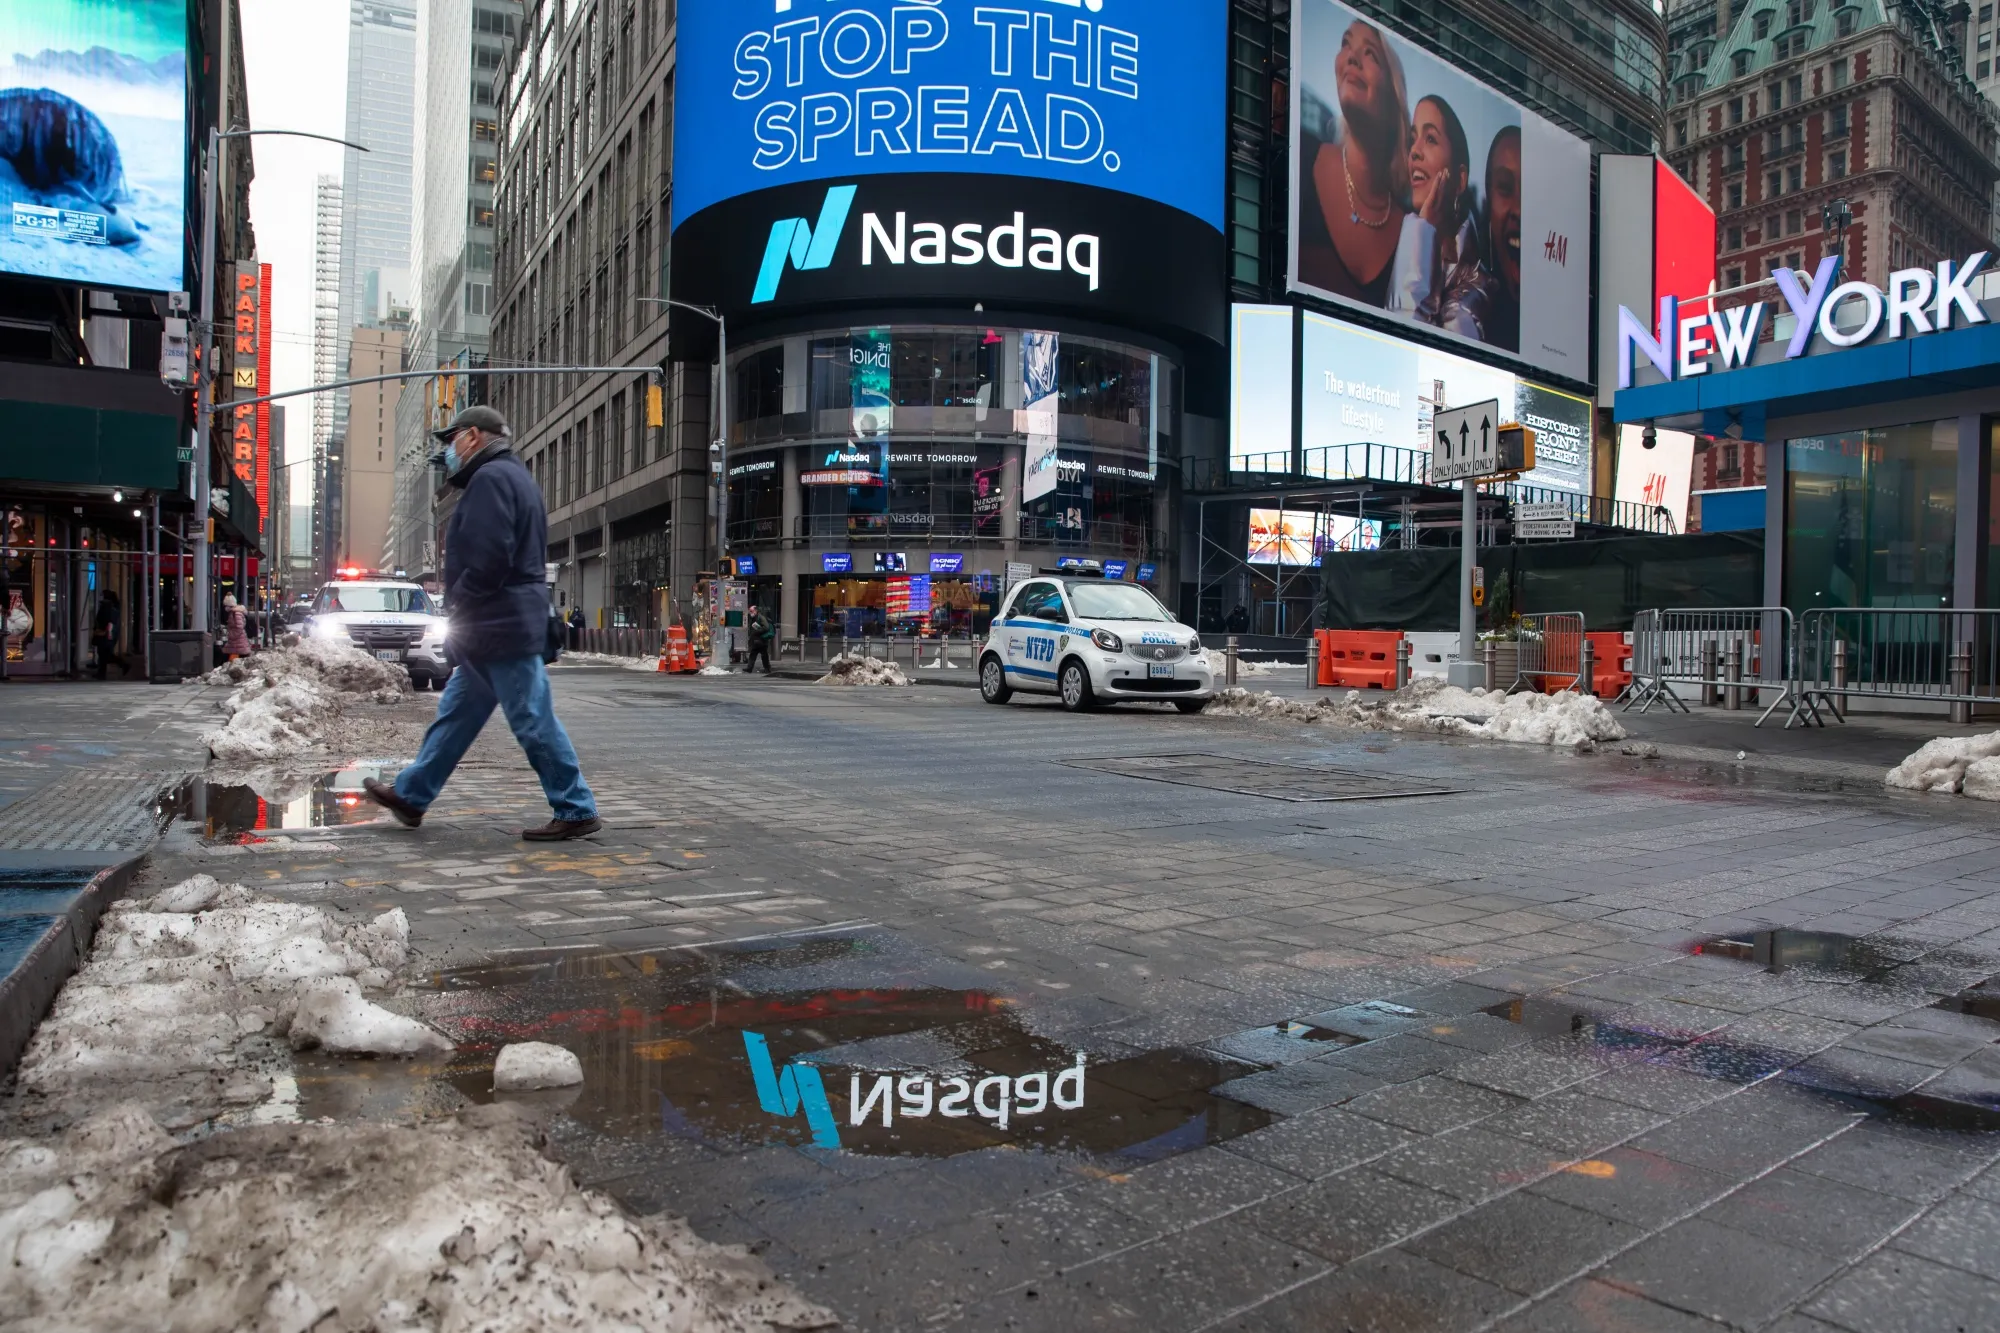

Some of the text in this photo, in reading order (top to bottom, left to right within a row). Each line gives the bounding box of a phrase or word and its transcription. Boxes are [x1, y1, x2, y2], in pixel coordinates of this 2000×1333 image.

[732, 6, 1139, 100] STOP THE
[752, 86, 1121, 172] SPREAD.
[15, 213, 57, 229] PG-13
[861, 211, 1100, 292] Nasdaq
[1543, 230, 1568, 268] H&M
[235, 273, 256, 354] PARK
[1324, 370, 1401, 410] The waterfront
[1342, 403, 1384, 436] lifestyle
[1526, 413, 1581, 437] HISTORIC
[234, 402, 254, 481] PARK
[1534, 431, 1580, 452] RONT
[839, 453, 870, 464] Nasdaq
[885, 454, 978, 463] REWRITE TOMORROW
[1474, 457, 1494, 471] ONLY
[1534, 446, 1580, 465] TREET
[746, 460, 776, 472] TOMORROW
[1056, 460, 1085, 472] Nasdaq
[1098, 465, 1126, 476] REWRITE
[1434, 465, 1452, 478] ONLY
[1453, 461, 1472, 475] ONLY
[801, 473, 837, 484] BRANDED
[839, 471, 869, 482] CITIES
[1642, 472, 1667, 506] H&M
[890, 513, 934, 526] Nasdaq
[1065, 626, 1085, 636] POLICE
[1025, 635, 1055, 663] NYPD
[1142, 636, 1177, 645] POLICE
